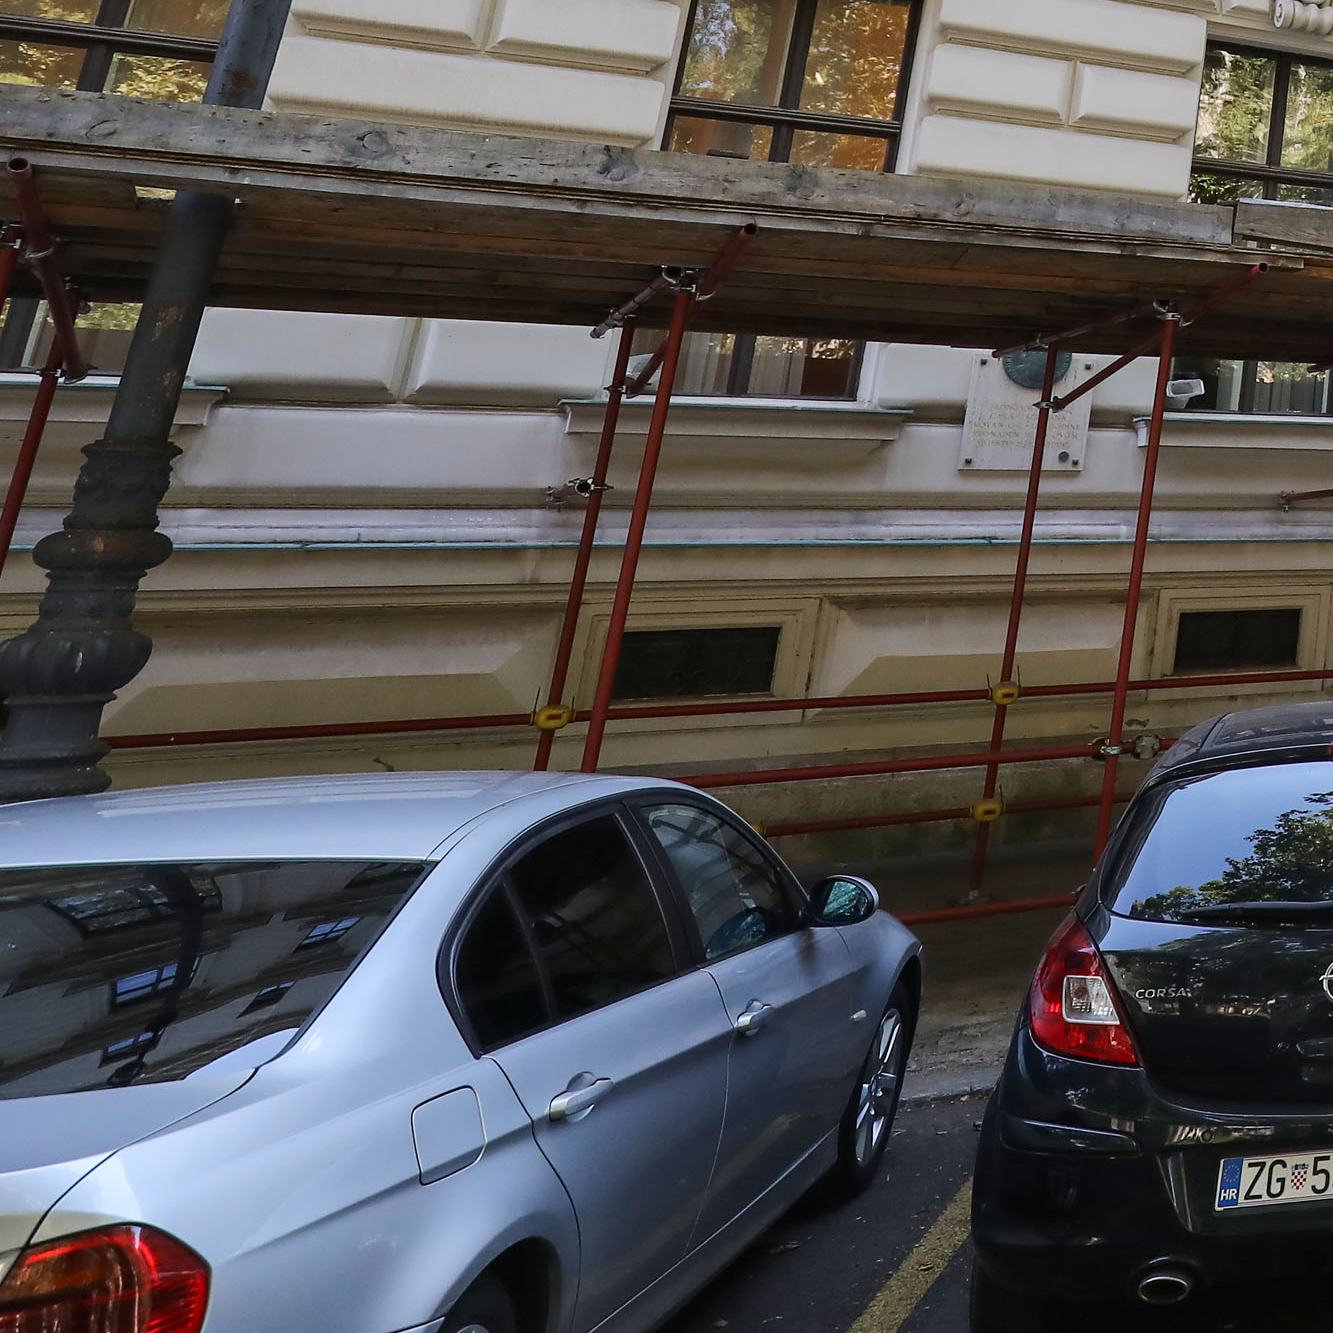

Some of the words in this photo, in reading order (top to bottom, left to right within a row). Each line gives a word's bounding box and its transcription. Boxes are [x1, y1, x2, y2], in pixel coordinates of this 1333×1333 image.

[1135, 987, 1187, 999] CORSA
[1220, 1188, 1238, 1201] HR
[1243, 1159, 1288, 1201] ZG
